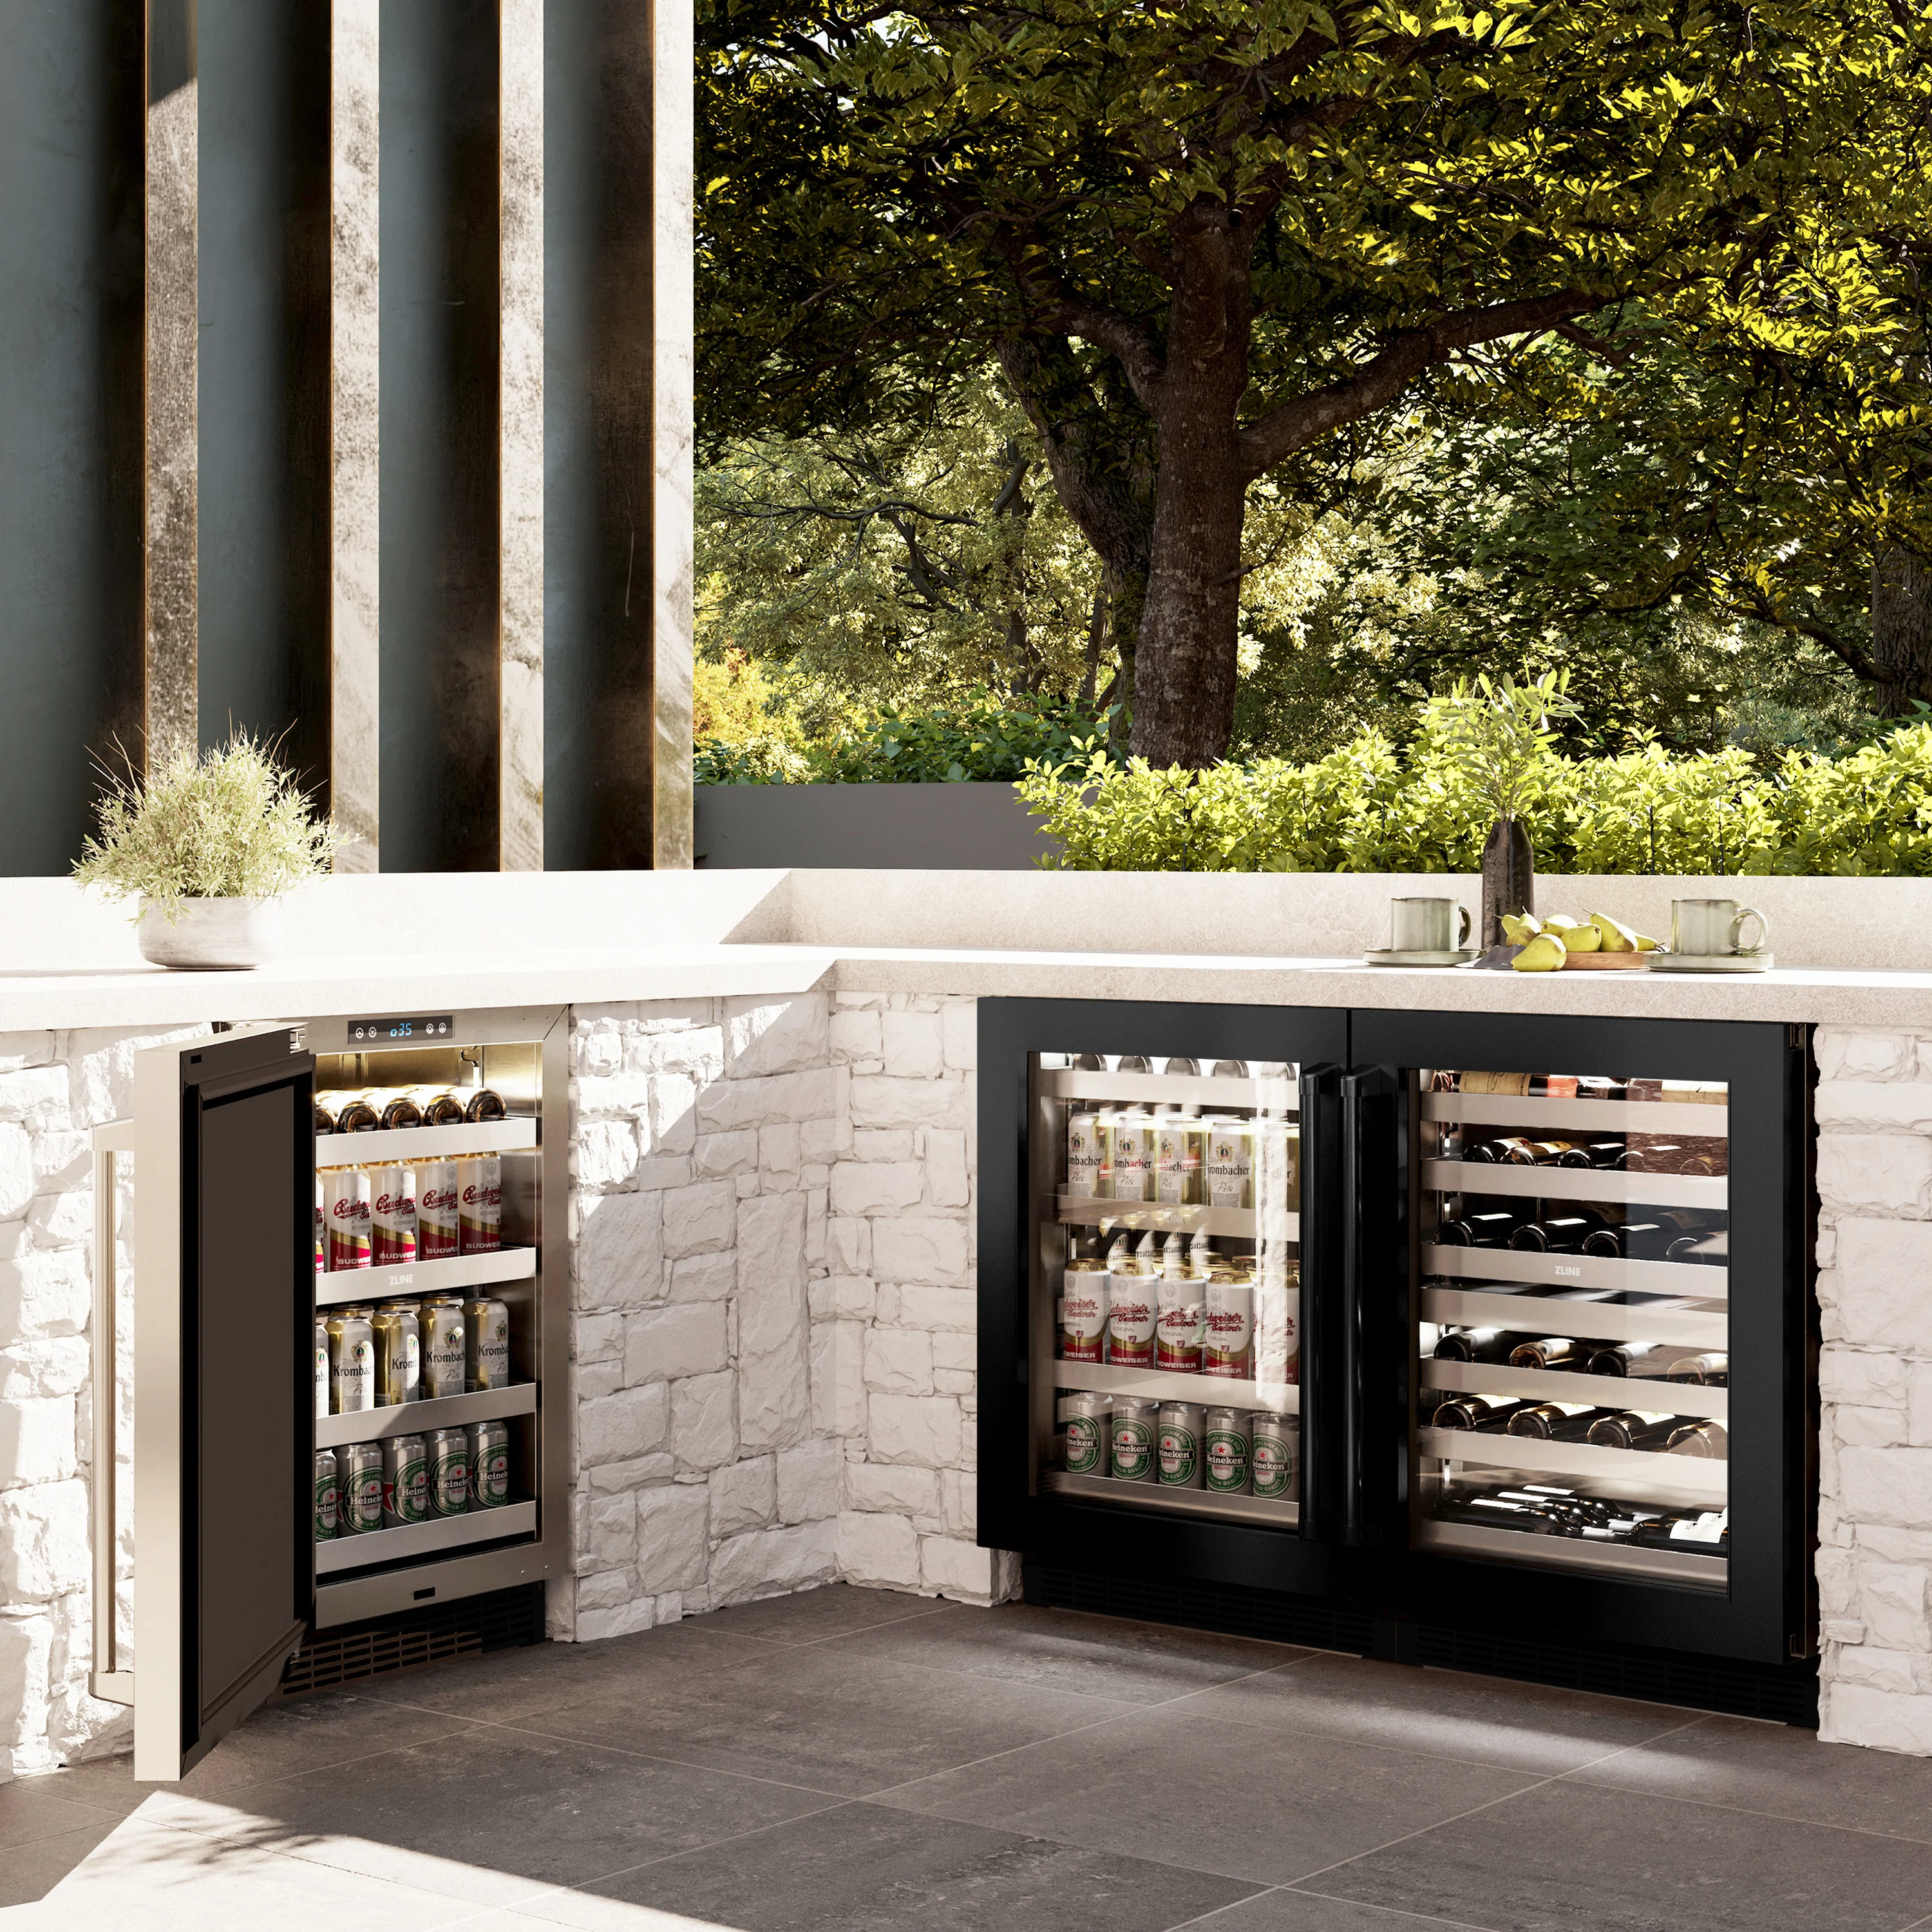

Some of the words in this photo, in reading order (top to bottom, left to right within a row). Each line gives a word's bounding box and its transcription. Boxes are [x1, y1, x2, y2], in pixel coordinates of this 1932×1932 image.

[1069, 1172, 1084, 1182] Pils
[1215, 1181, 1234, 1193] Pils
[1554, 1265, 1580, 1276] ZLINE
[389, 1274, 413, 1285] ZLINE
[441, 1370, 460, 1381] Pils
